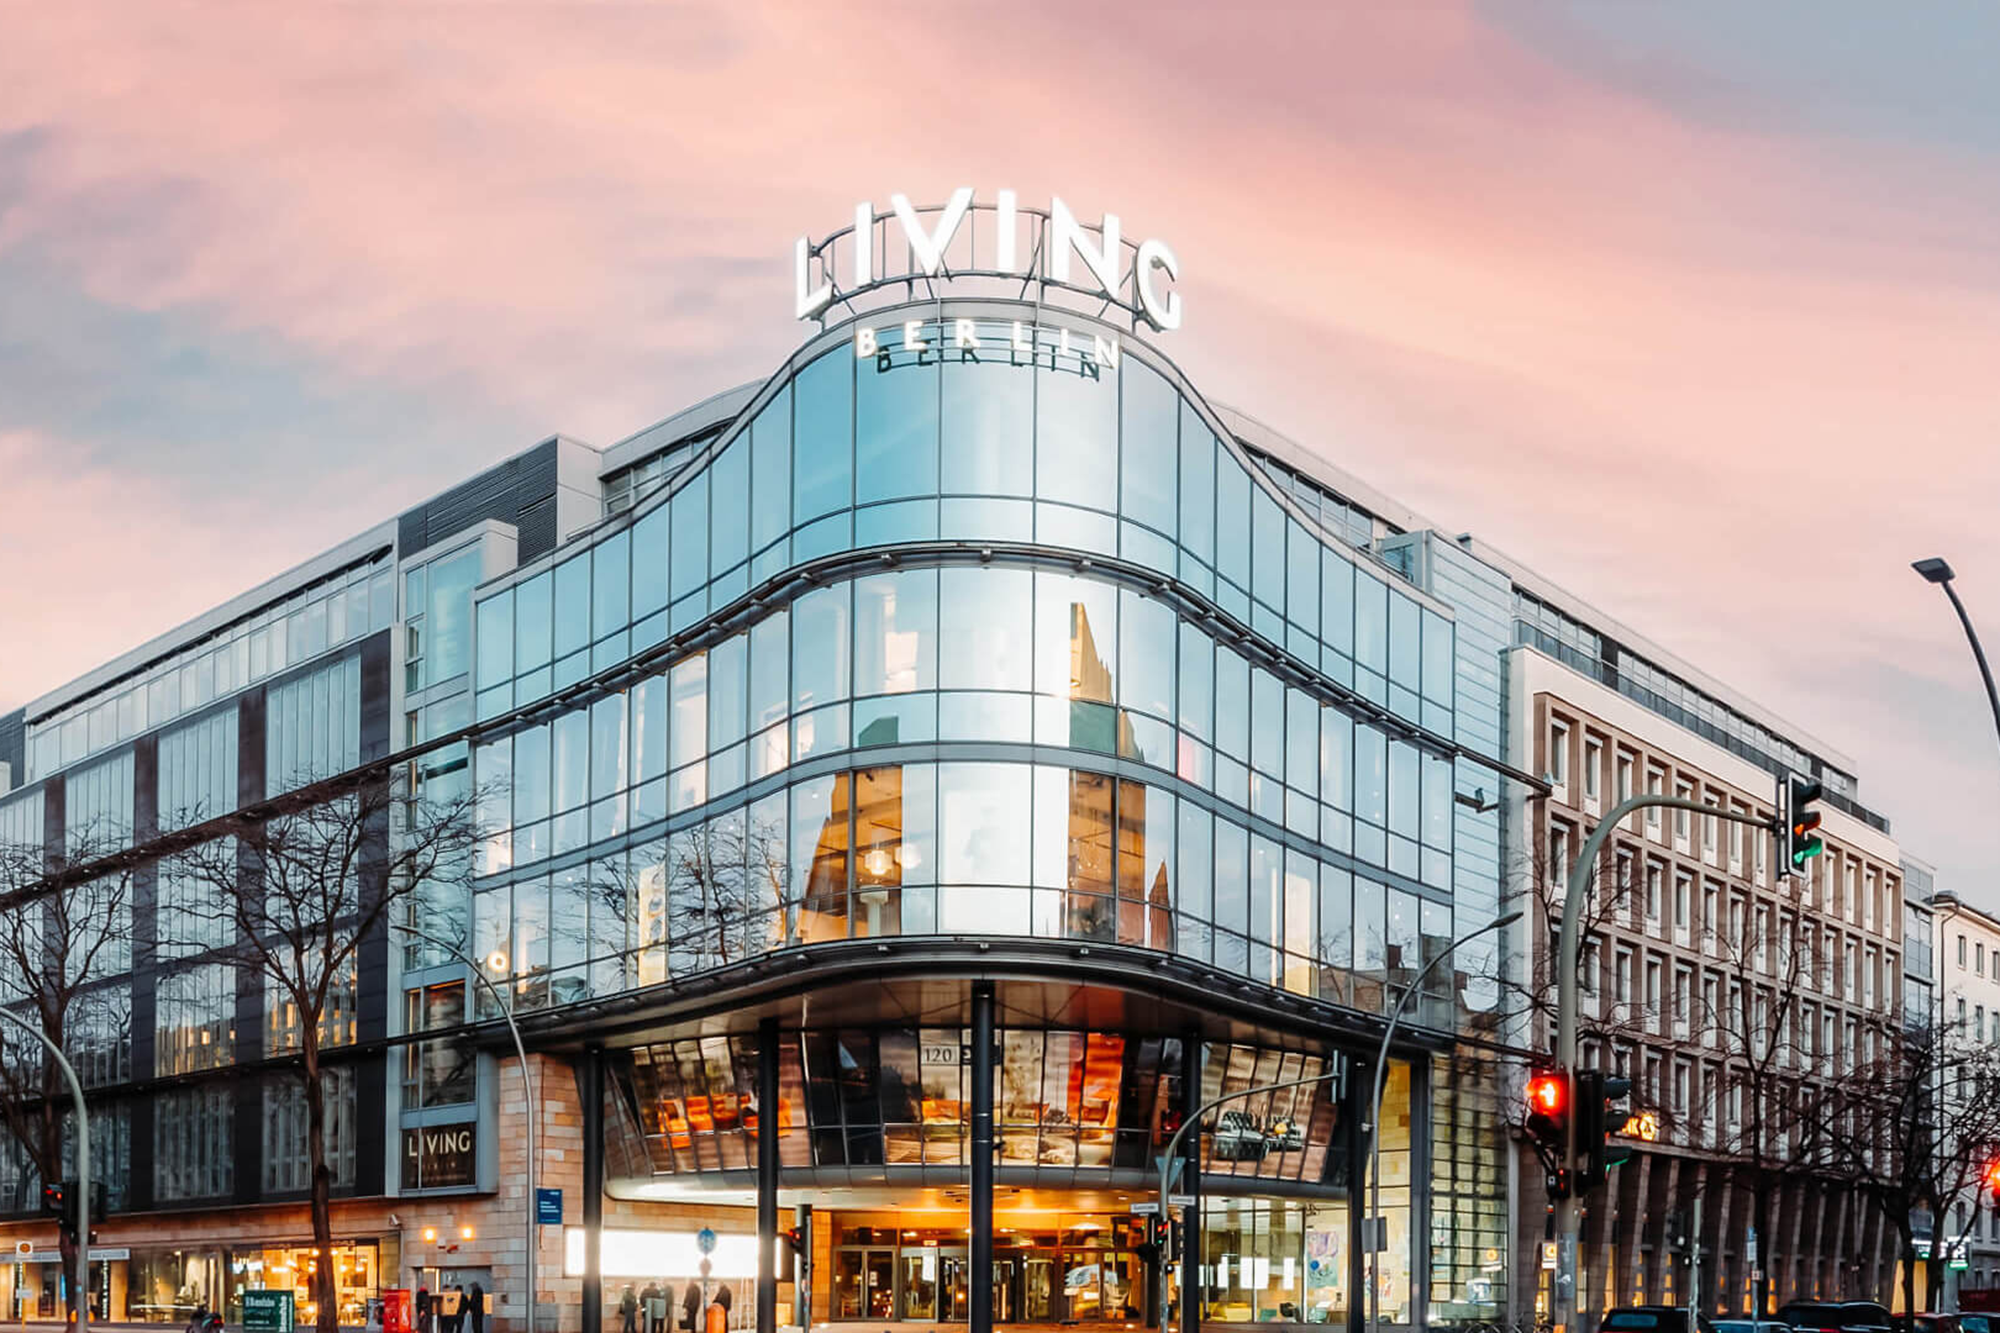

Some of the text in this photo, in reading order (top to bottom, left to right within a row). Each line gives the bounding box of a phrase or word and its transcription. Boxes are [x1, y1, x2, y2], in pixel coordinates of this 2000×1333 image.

[796, 187, 1181, 332] LIVING
[856, 318, 1119, 369] BERLIN
[924, 1047, 952, 1063] 120
[408, 1131, 471, 1157] LIVING
